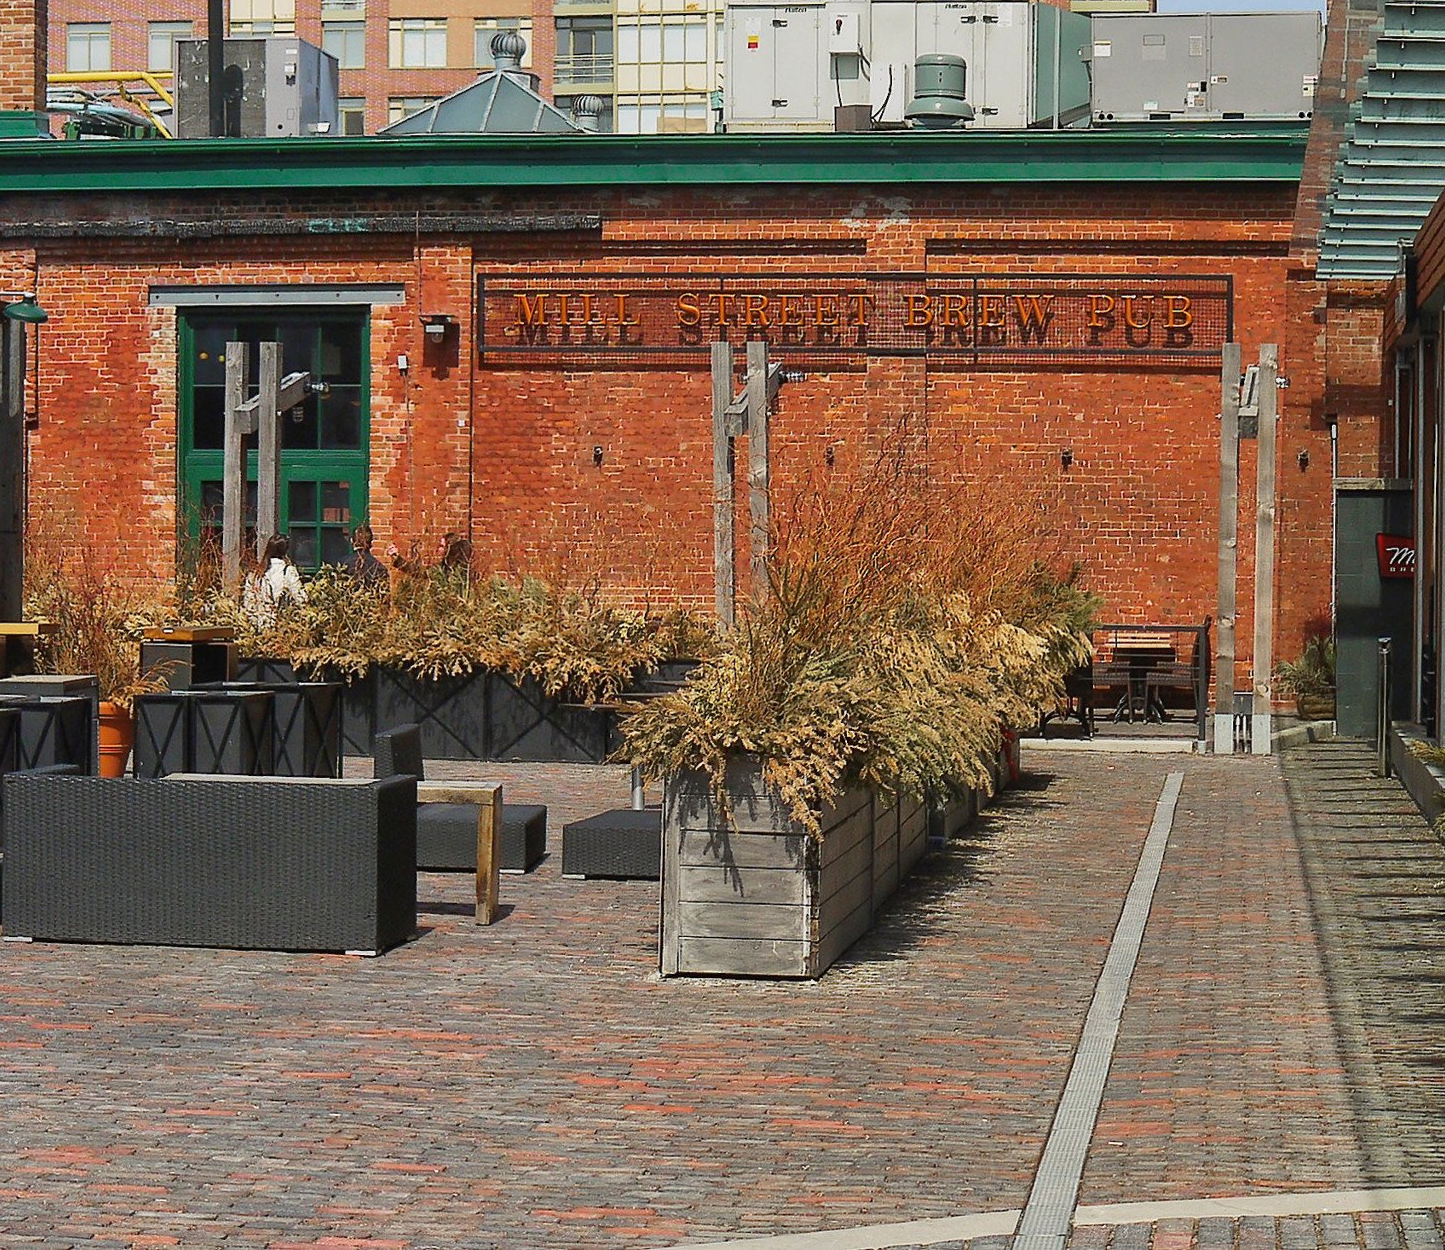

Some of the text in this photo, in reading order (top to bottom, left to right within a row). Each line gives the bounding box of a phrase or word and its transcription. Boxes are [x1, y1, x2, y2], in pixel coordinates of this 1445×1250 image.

[513, 293, 1194, 329] MILL STREET BREW PUB
